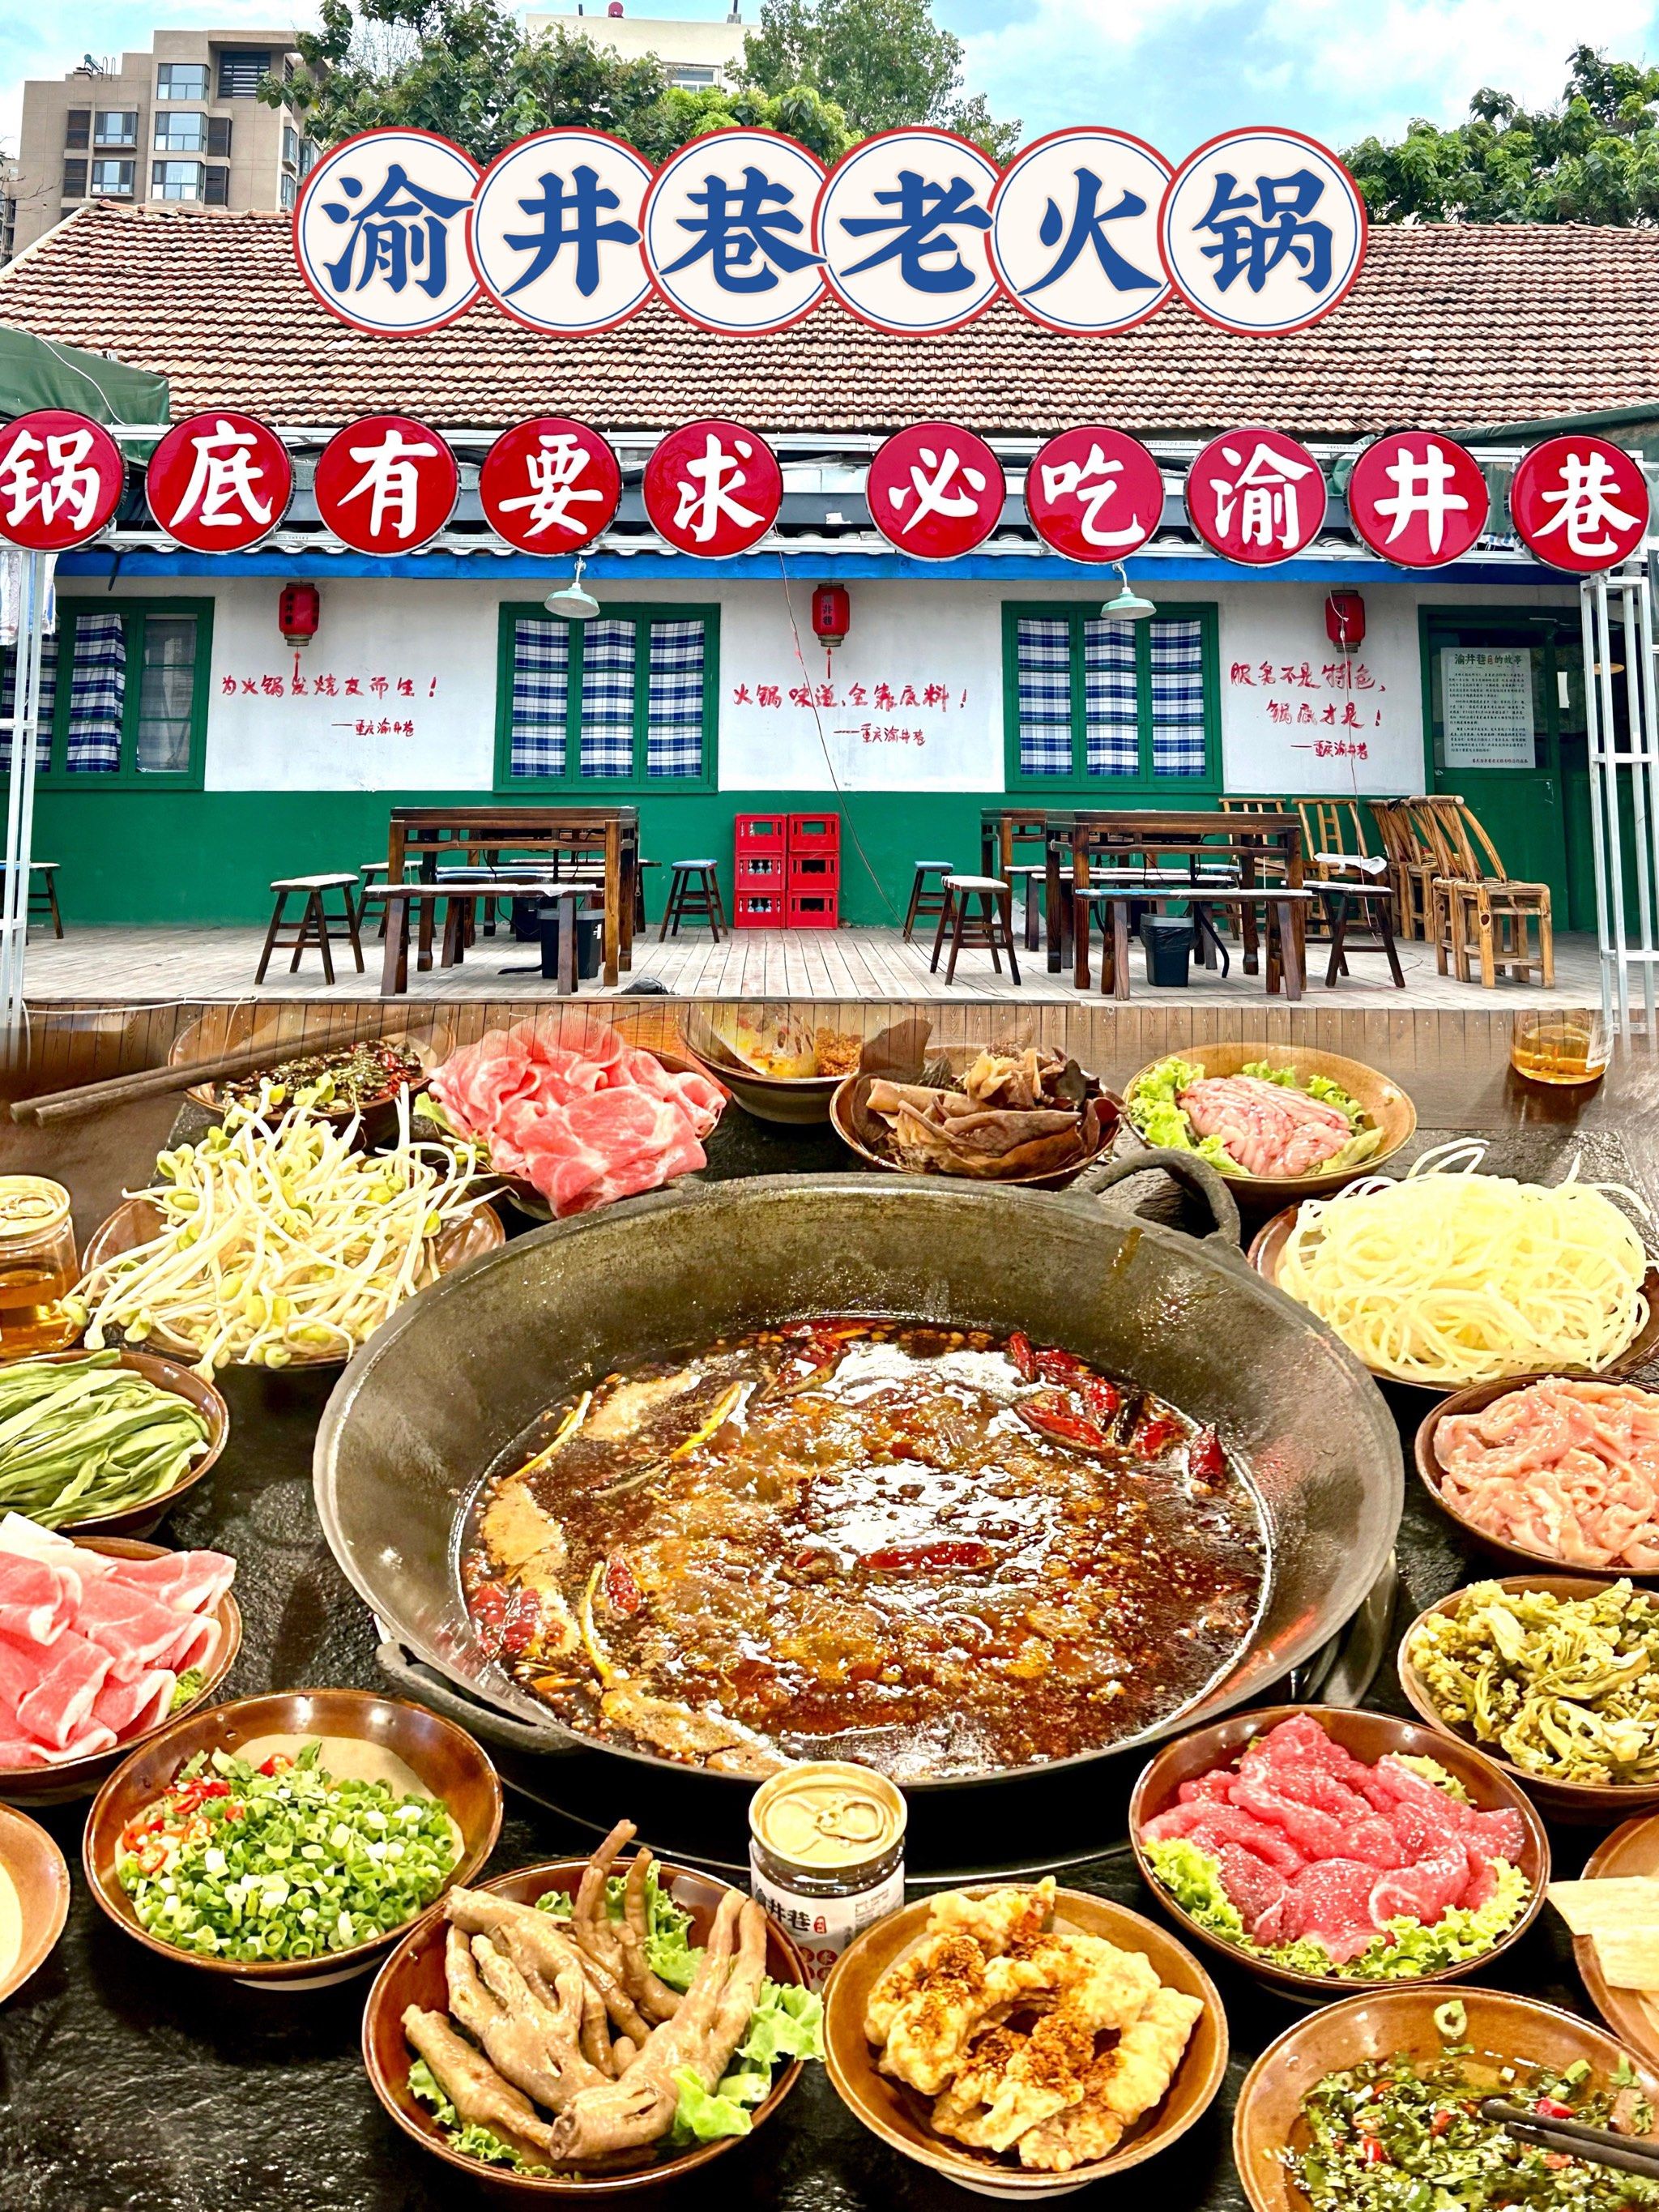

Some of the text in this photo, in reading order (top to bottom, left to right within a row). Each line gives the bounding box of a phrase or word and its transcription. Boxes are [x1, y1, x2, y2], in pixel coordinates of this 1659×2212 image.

[0, 420, 1641, 555] 锅底有要求 必吃渝井巷
